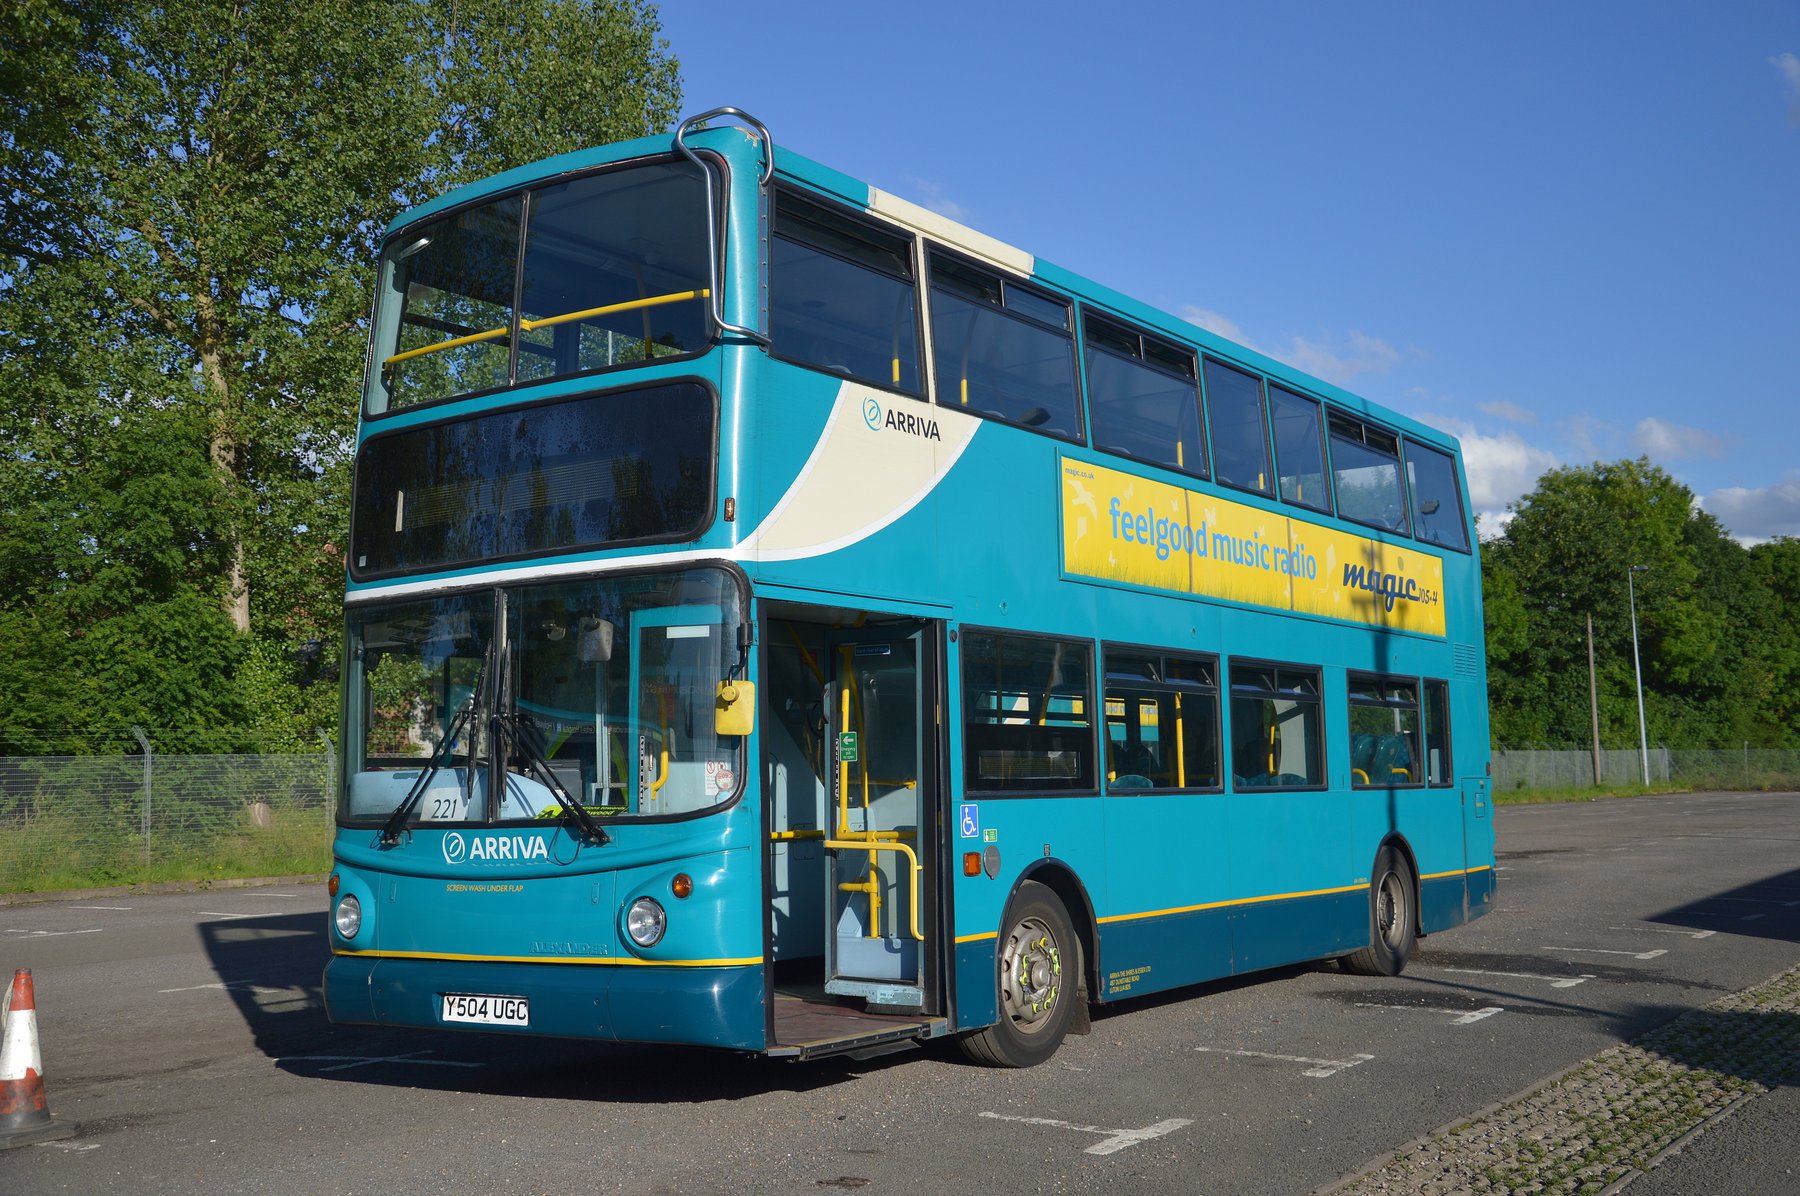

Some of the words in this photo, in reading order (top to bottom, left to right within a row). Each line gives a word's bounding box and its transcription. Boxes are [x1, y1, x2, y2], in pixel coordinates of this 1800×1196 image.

[885, 409, 941, 441] ARRIVA
[1065, 467, 1095, 480] magic.co.uk
[1109, 497, 1208, 560] feelgood
[1212, 531, 1270, 570] music
[1273, 544, 1316, 580] radio
[1343, 558, 1420, 612] magic
[431, 799, 458, 819] 221
[469, 836, 548, 859] ARRIVA
[446, 884, 468, 892] SCREEN
[469, 884, 486, 892] WASH
[487, 884, 508, 892] UNDER
[509, 884, 524, 892] FLAP
[529, 941, 608, 956] ALEXANDER
[446, 996, 488, 1018] Y504
[493, 999, 527, 1021] UGC
